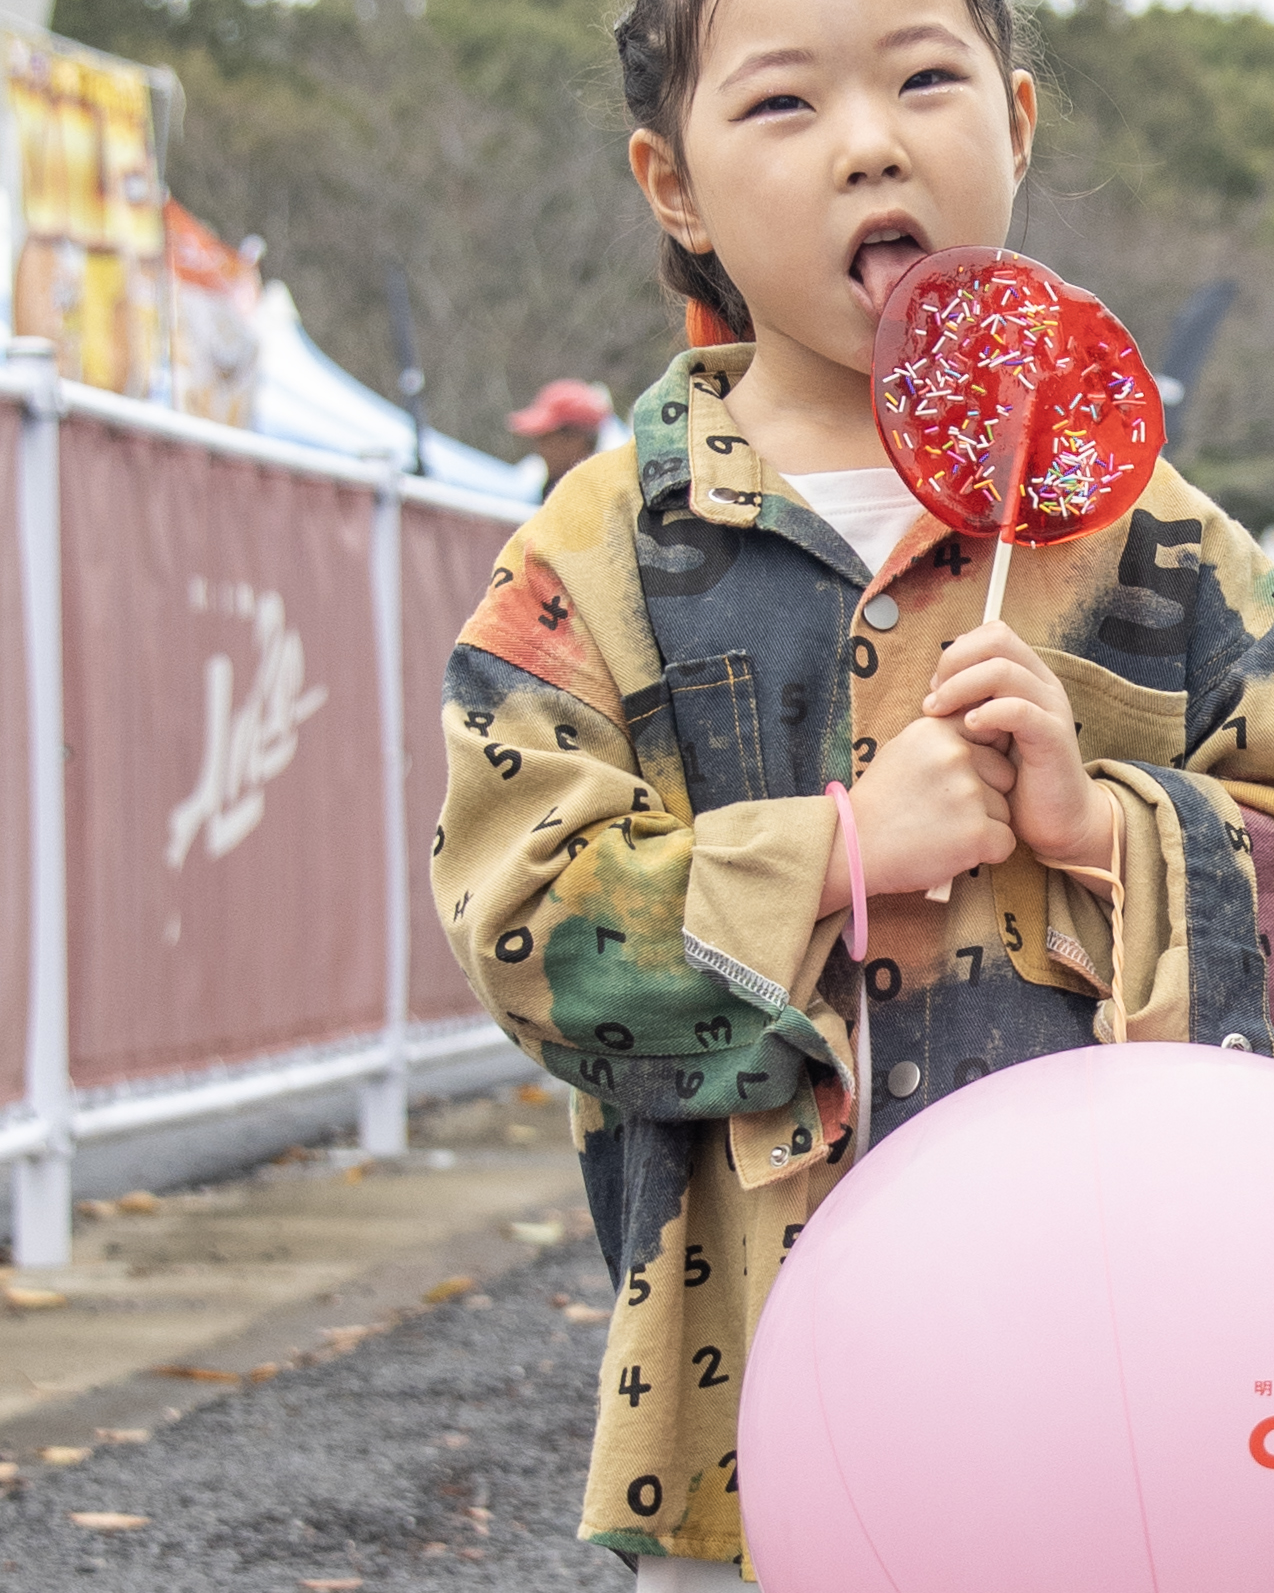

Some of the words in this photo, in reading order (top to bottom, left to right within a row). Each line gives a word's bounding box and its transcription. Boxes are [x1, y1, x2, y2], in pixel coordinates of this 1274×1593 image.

[1099, 508, 1202, 657] 5
[538, 595, 568, 630] 4
[848, 635, 879, 679] 0
[484, 742, 522, 781] 5
[495, 925, 534, 963] 0
[864, 957, 902, 1002] 0
[957, 946, 984, 987] 7
[595, 1021, 634, 1050] 0
[695, 1015, 732, 1048] 3
[629, 1264, 652, 1306] 5
[685, 1244, 711, 1287] 5
[618, 1365, 652, 1407] 4
[691, 1344, 730, 1388] 2
[627, 1473, 664, 1516] 0
